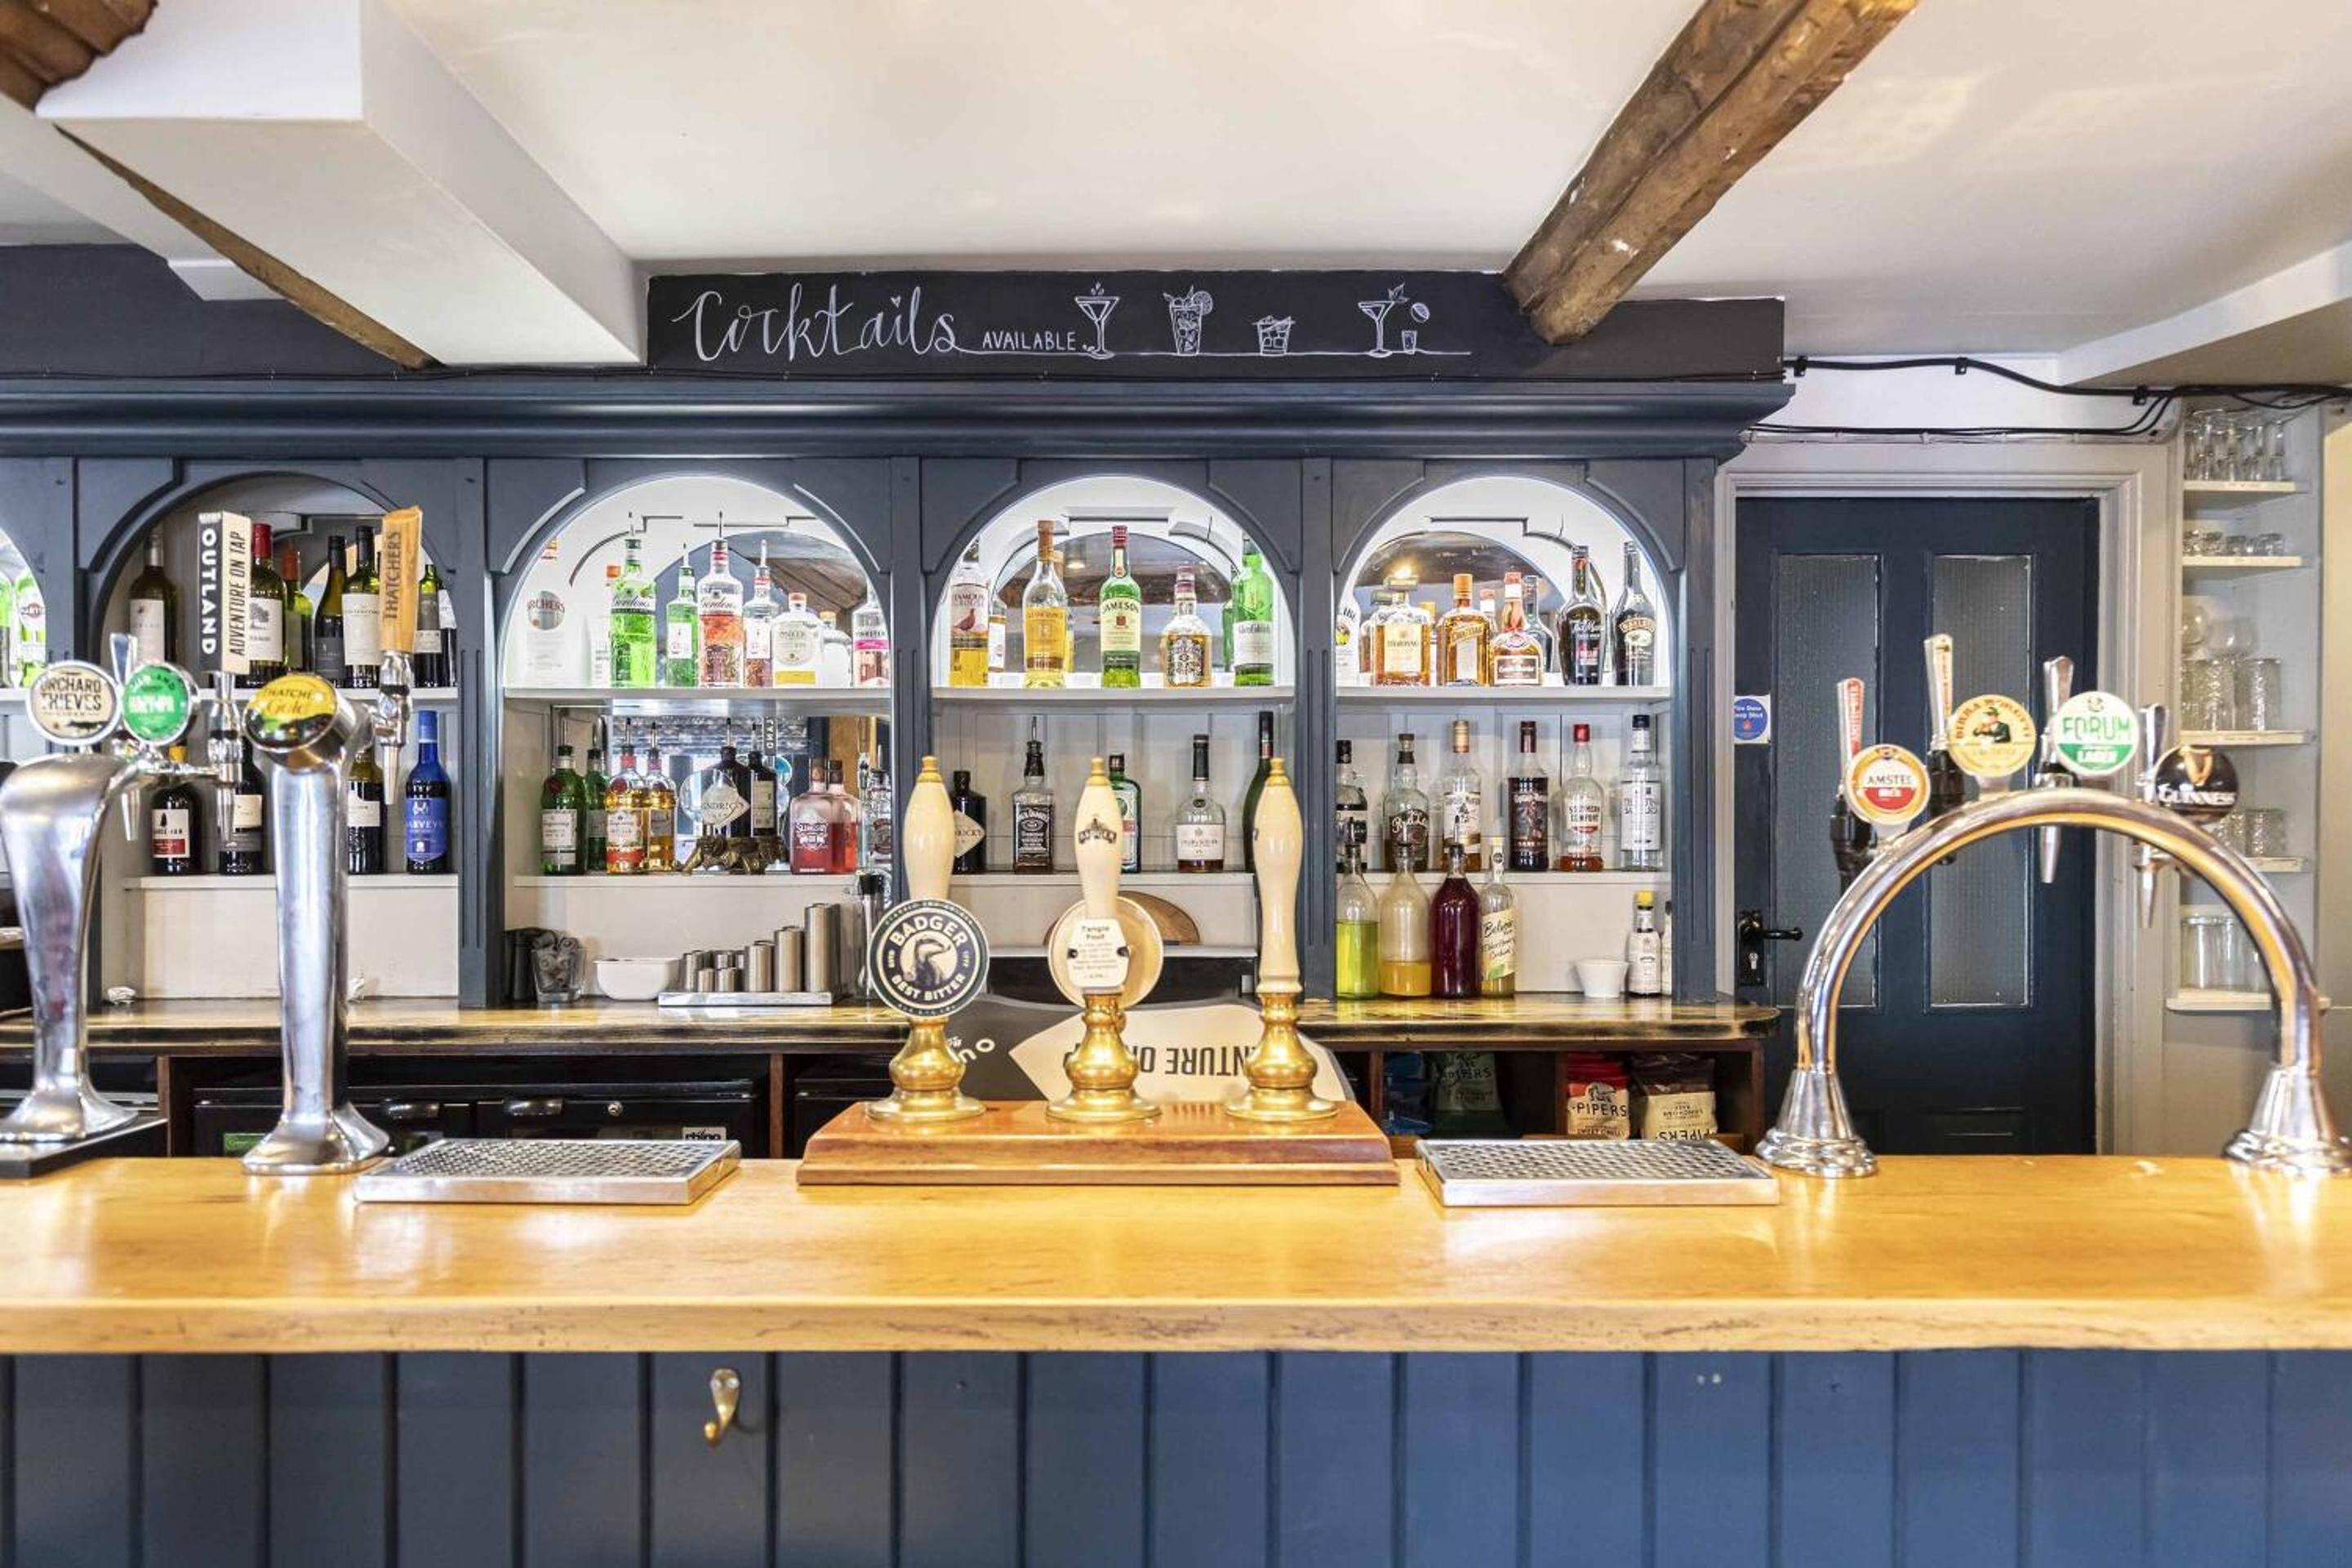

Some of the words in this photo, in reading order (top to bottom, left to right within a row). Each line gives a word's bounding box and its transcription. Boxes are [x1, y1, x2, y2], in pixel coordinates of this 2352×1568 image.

[671, 282, 958, 362] Cocktails
[982, 330, 1076, 350] AVAILABLE
[229, 531, 247, 554] TAP
[229, 558, 245, 577] ON
[384, 531, 402, 621] THATCHERS
[202, 528, 217, 655] OUTLAND
[229, 582, 246, 656] ADVENTURE
[1102, 600, 1140, 614] JAMESON
[2061, 716, 2132, 740] FORUM
[2158, 784, 2237, 806] GUINNESS
[888, 914, 969, 948] BADGER
[891, 974, 922, 1000] BEST
[923, 973, 967, 1002] BITTER
[1164, 1046, 1257, 1077] NTURE
[1576, 1102, 1627, 1117] PIPERS
